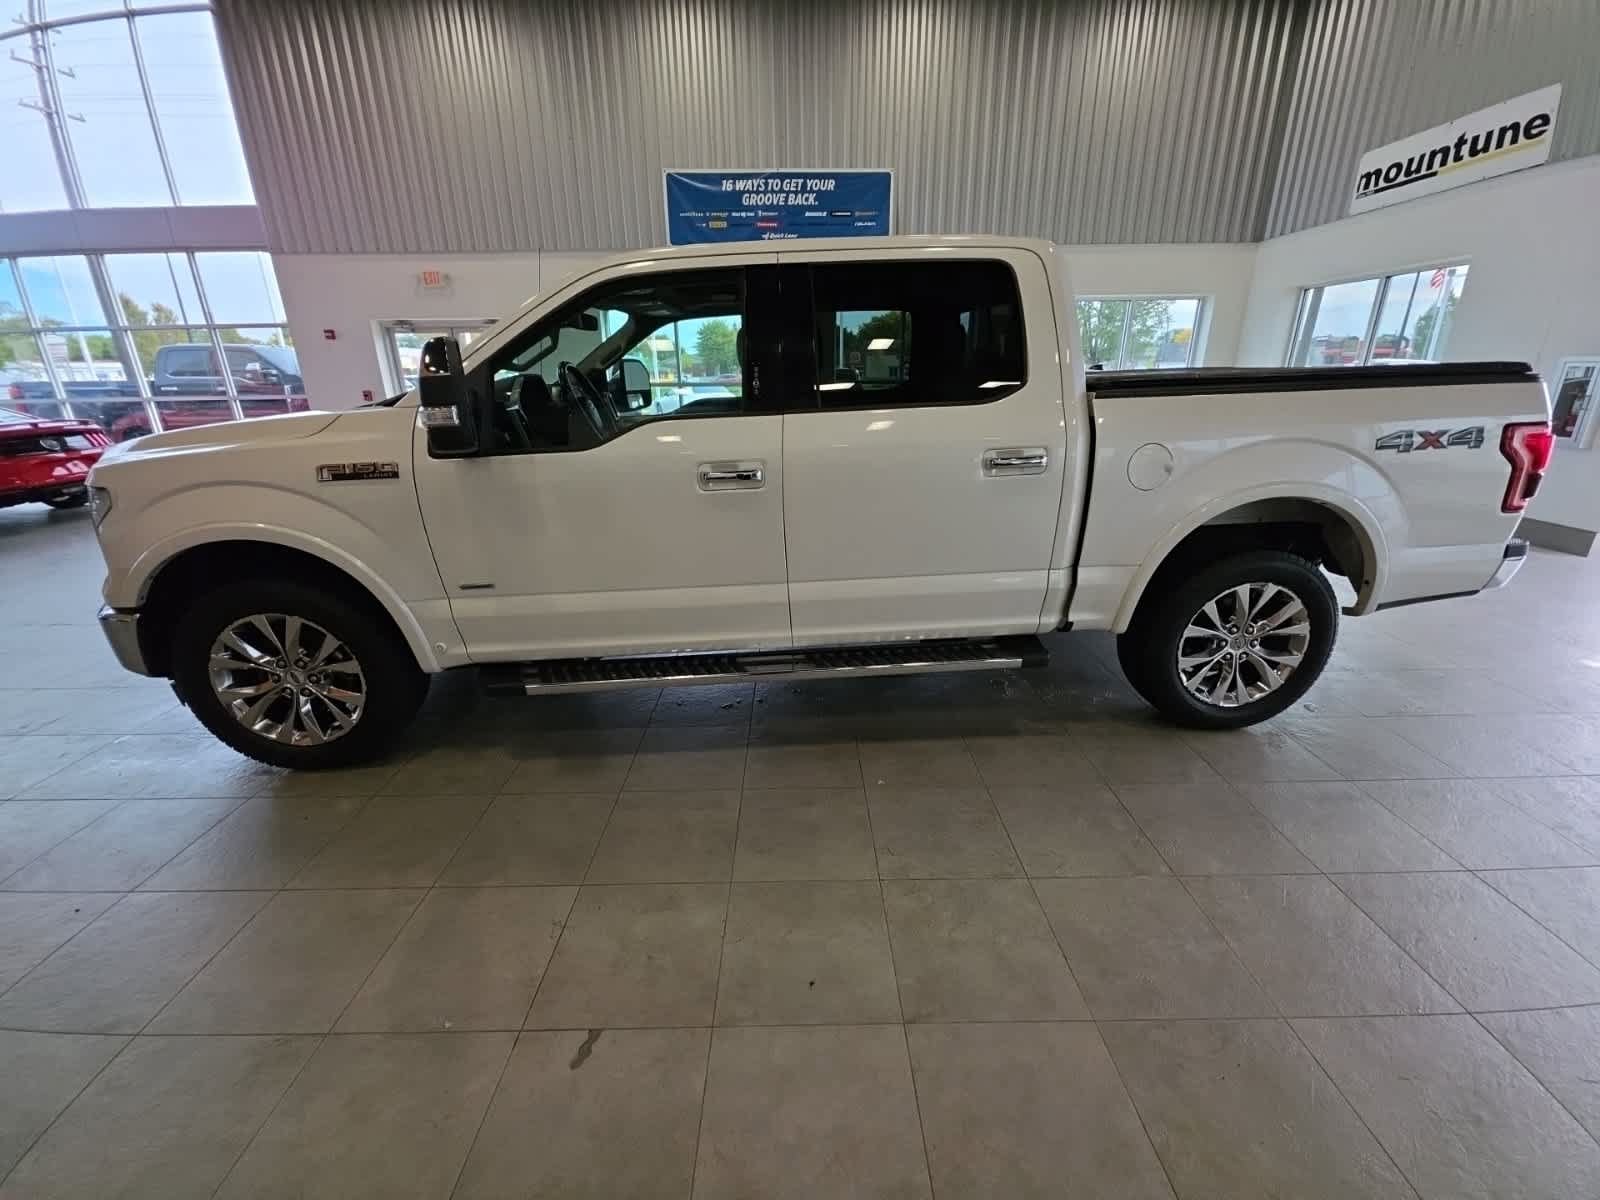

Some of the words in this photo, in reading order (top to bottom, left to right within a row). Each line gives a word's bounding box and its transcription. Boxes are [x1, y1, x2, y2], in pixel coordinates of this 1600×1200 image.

[1356, 112, 1552, 194] mountune
[721, 178, 734, 191] 16
[734, 178, 766, 191] WAYS
[767, 178, 781, 191] TO
[782, 178, 804, 191] GET
[806, 178, 836, 191] YOUR
[742, 193, 787, 206] GROOVE
[787, 193, 819, 205] BACK.
